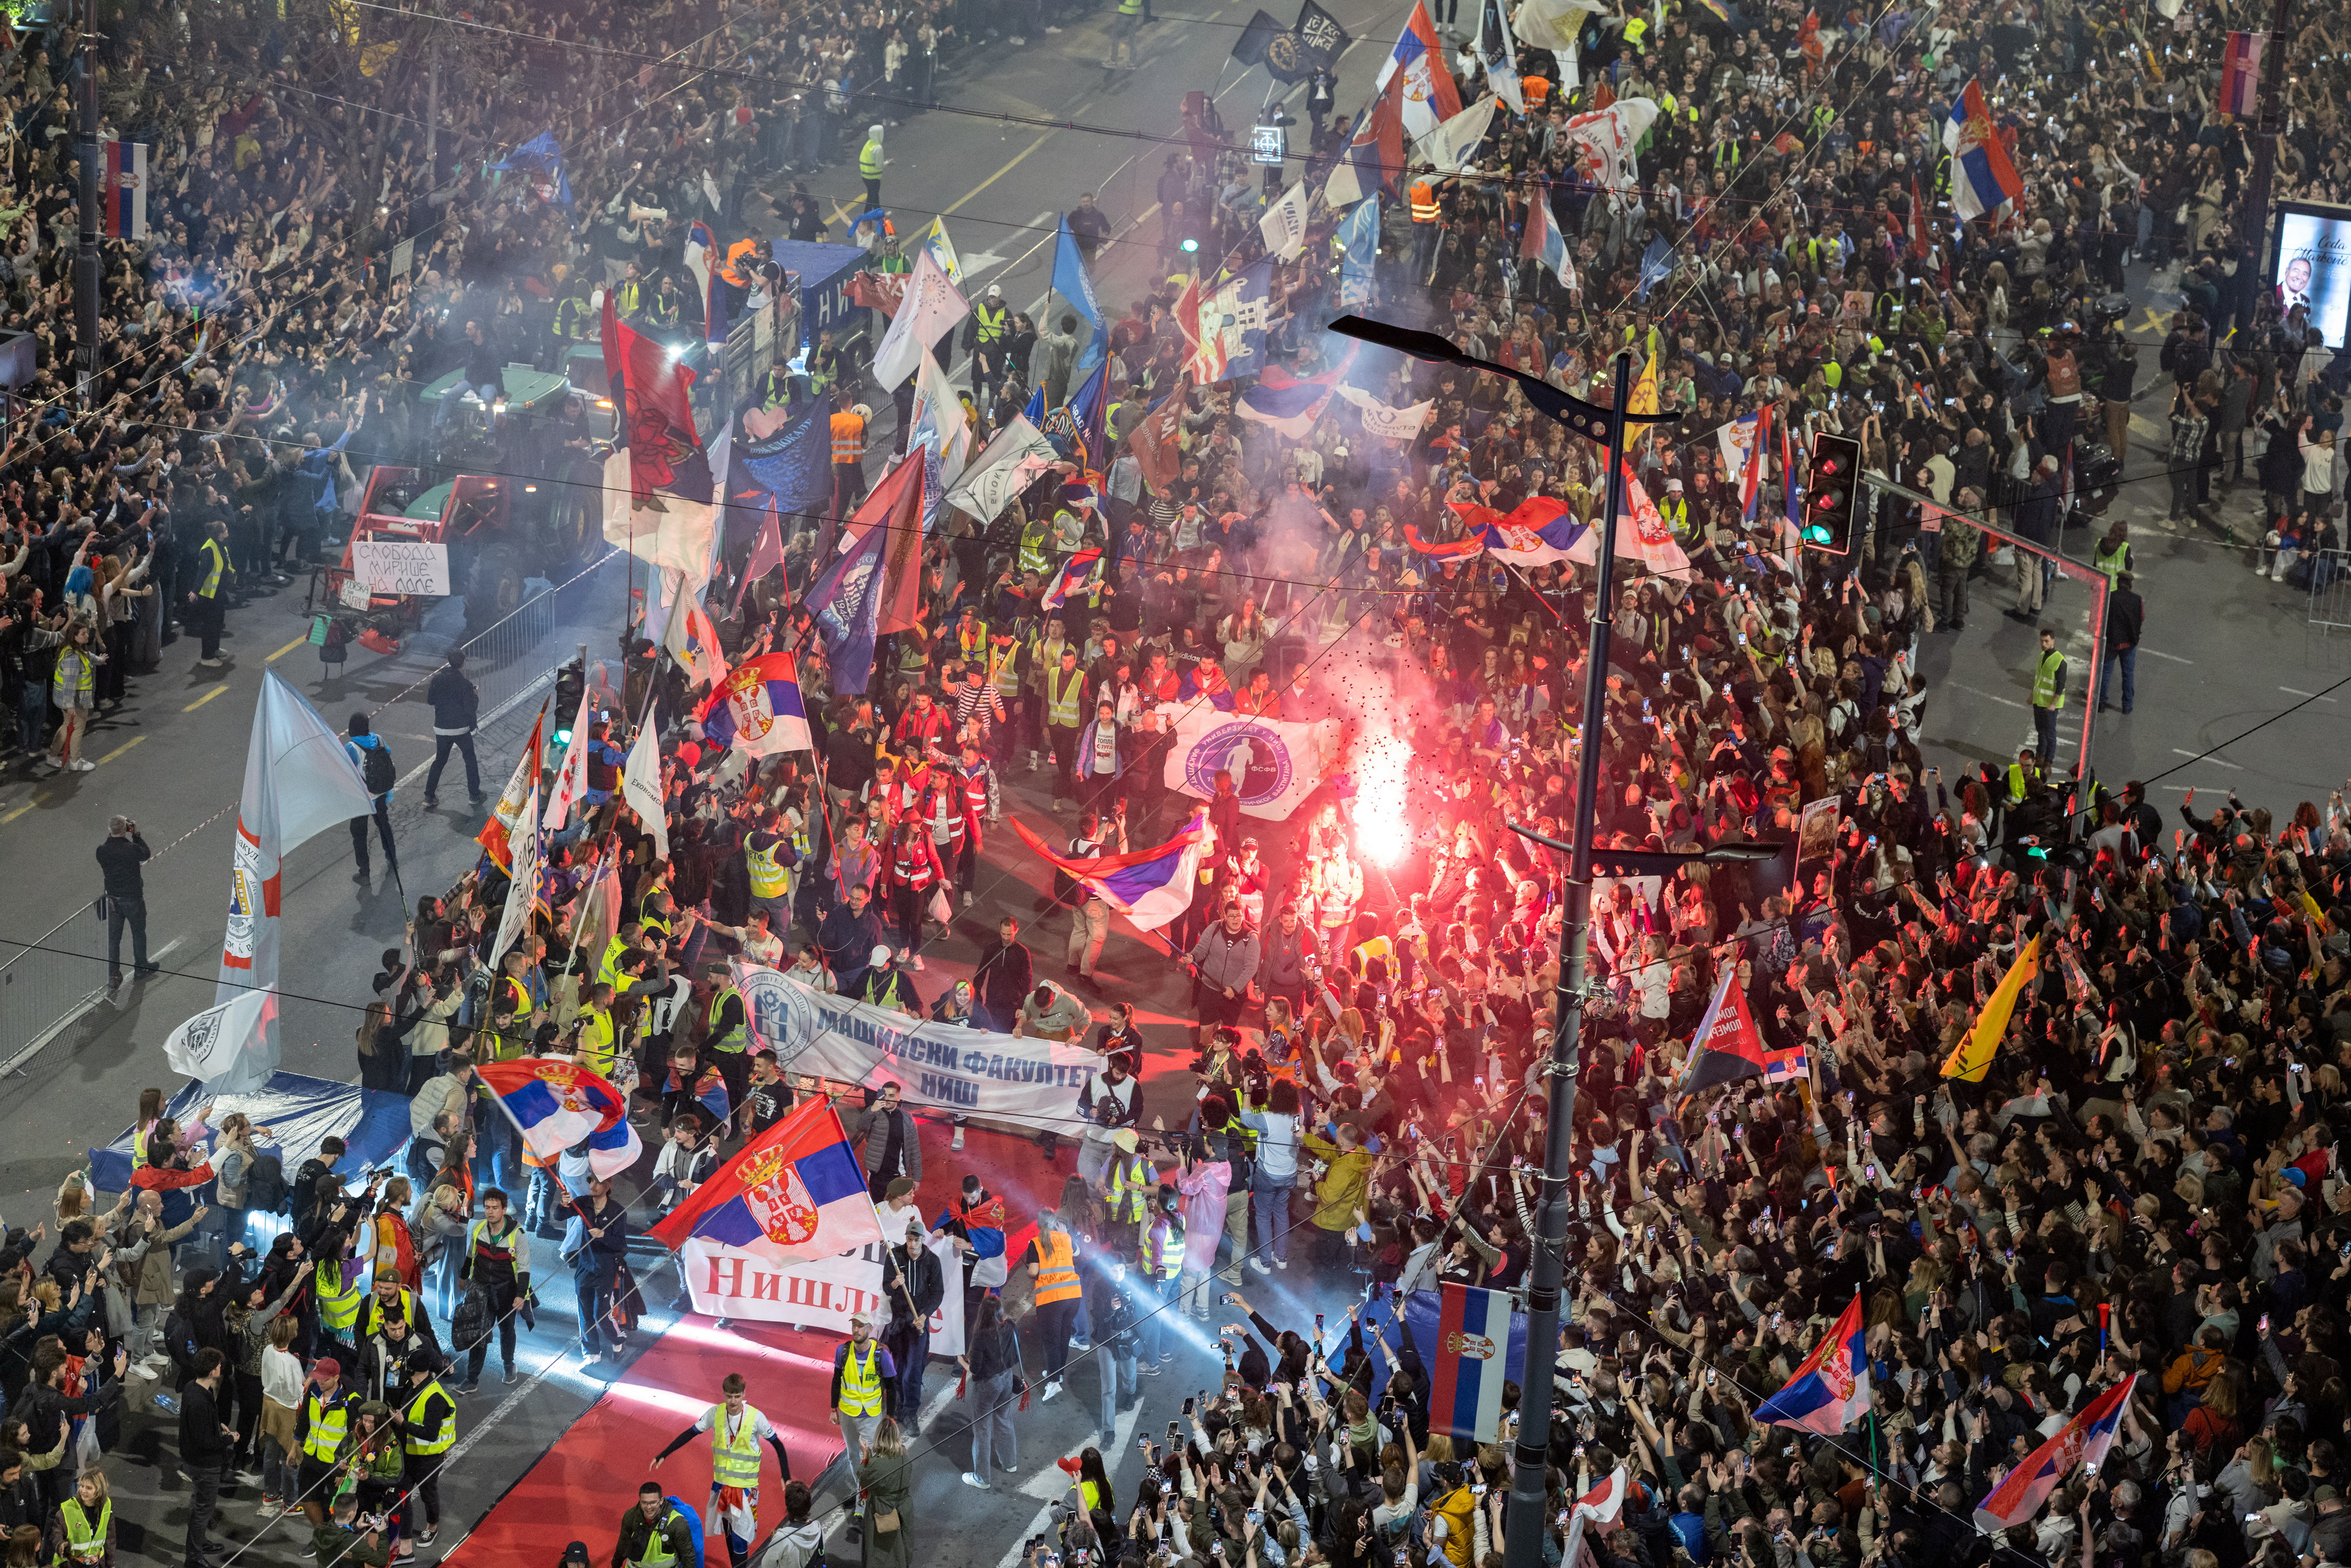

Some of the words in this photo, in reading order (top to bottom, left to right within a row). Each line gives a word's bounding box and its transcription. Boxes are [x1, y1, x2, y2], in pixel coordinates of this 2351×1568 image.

[360, 544, 436, 561] СЛОБОДА
[368, 577, 389, 592] НА
[396, 577, 435, 594] ЛАЛЕ
[835, 599, 850, 622] 1948
[1202, 724, 1259, 746] УНИВЕРЗИТЕТ
[1268, 735, 1285, 755] НИШУ
[1188, 748, 1201, 788] ФАКУЛТЕТ
[1272, 759, 1290, 797] ВАСПИТАЊА
[236, 832, 259, 863] факул
[748, 848, 765, 863] ЕТФ
[818, 1007, 958, 1070] МАШИНСКИ
[963, 1050, 1098, 1088] ФАКУЛТЕТ
[921, 1073, 979, 1107] НИШ
